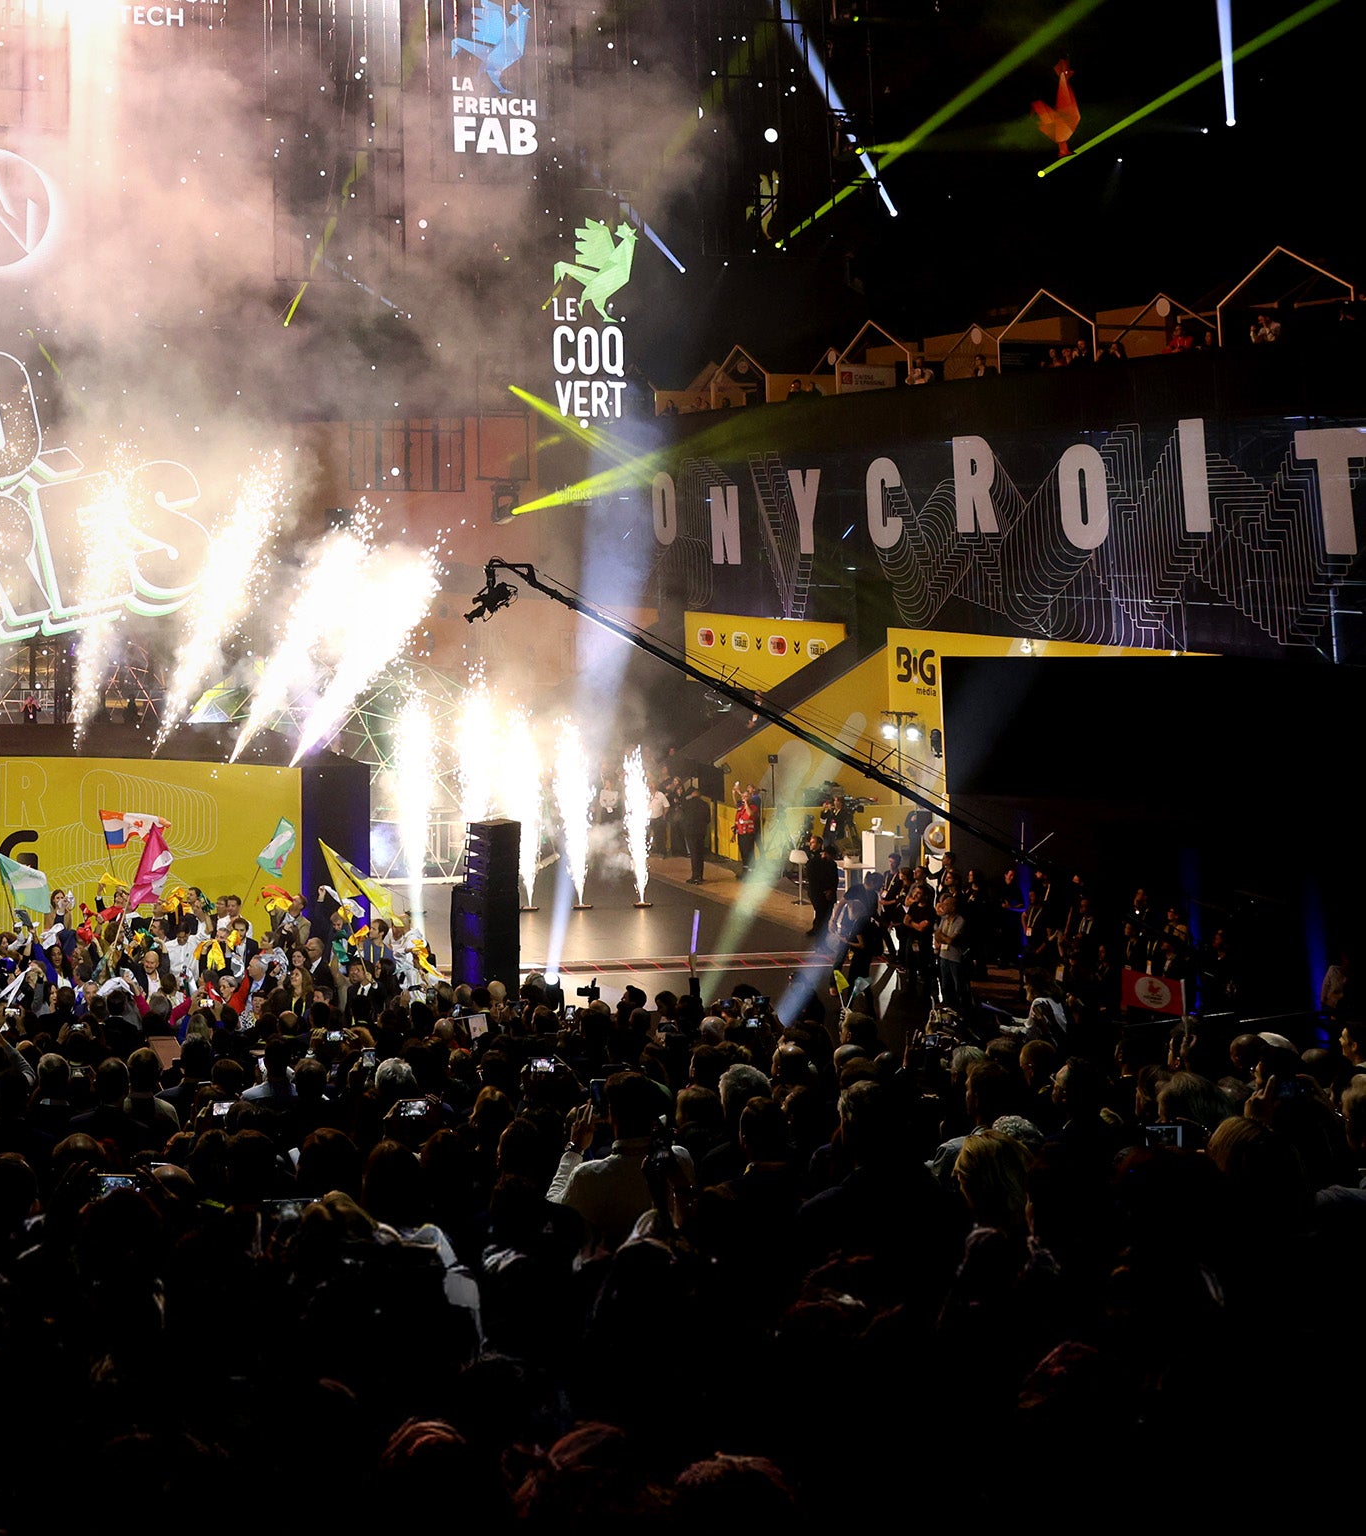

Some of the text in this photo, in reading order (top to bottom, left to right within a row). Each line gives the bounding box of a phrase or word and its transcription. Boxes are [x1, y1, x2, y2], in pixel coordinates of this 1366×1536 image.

[120, 5, 184, 27] TECH
[452, 76, 474, 91] LA
[453, 95, 537, 116] FRENCH
[453, 116, 538, 155] FAB
[552, 297, 577, 321] LE
[553, 325, 625, 377] COQ
[554, 380, 627, 418] VERT
[651, 417, 1366, 566] ON Y CROIT
[916, 686, 937, 697] média
